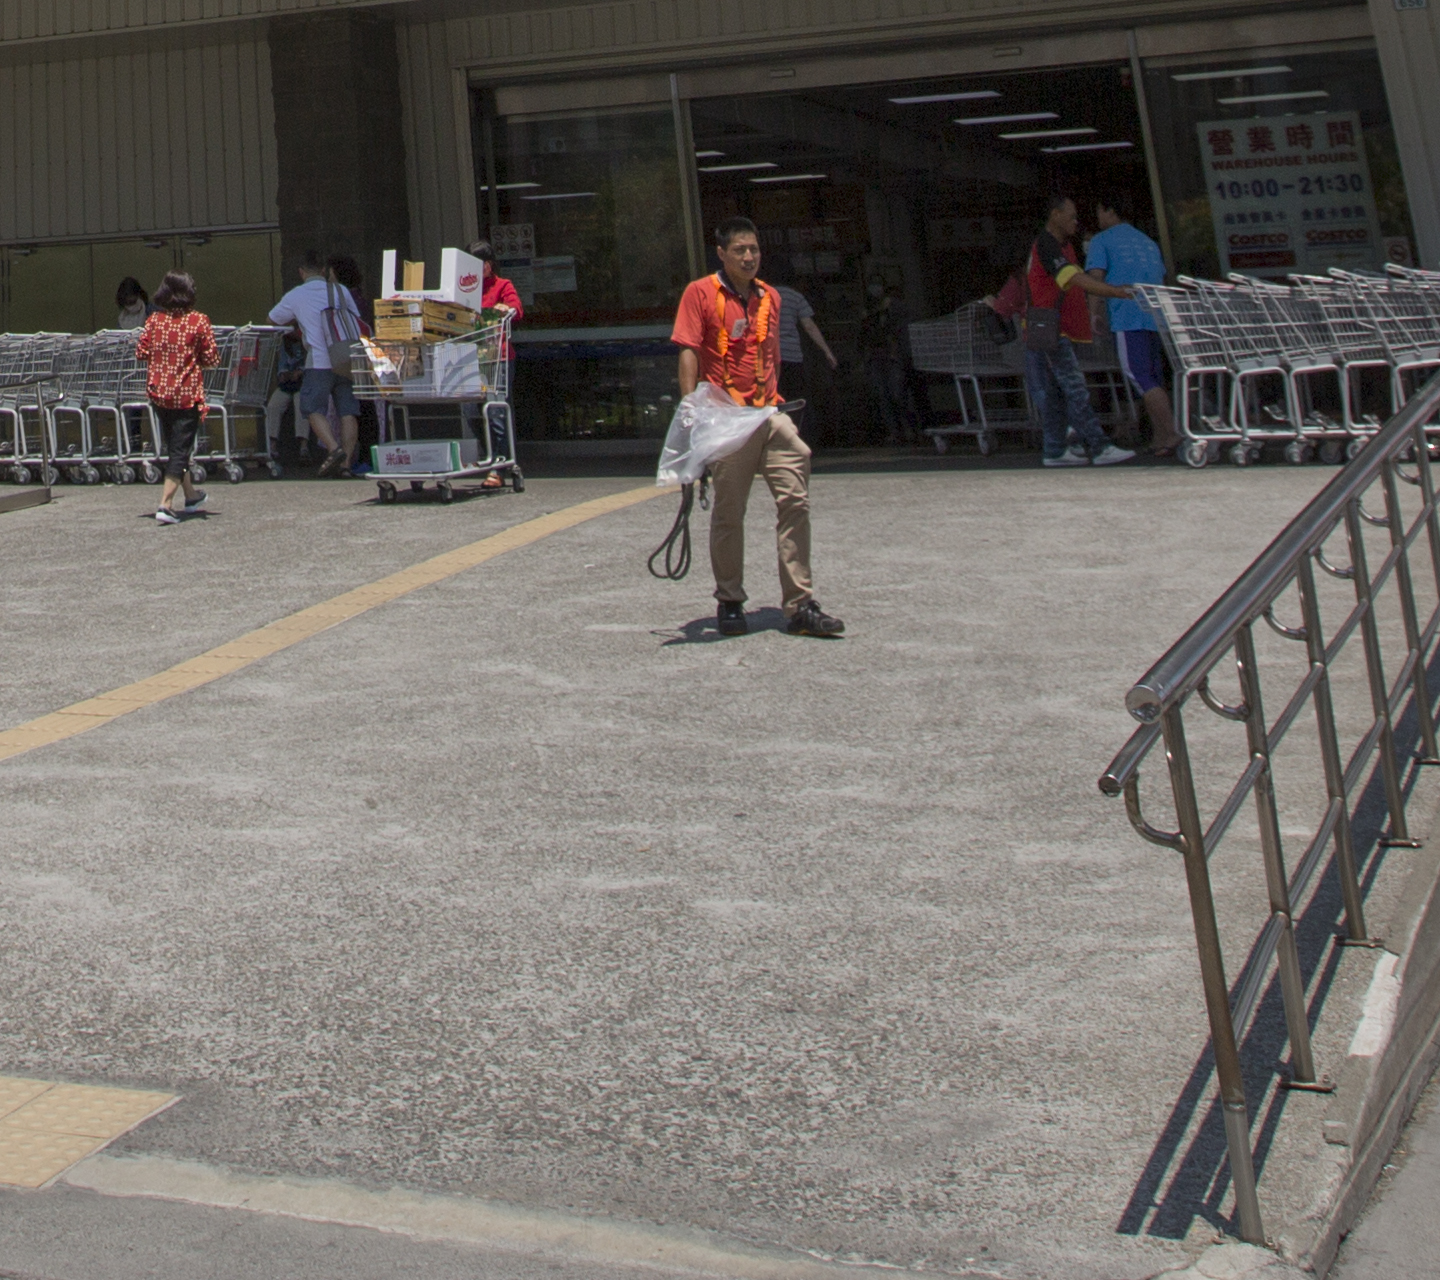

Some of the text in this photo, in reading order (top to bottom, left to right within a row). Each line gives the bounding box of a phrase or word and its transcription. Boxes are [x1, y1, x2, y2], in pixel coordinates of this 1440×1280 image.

[1207, 120, 1355, 156] 營業時間
[1211, 151, 1358, 171] WAREHOUSE HOURS
